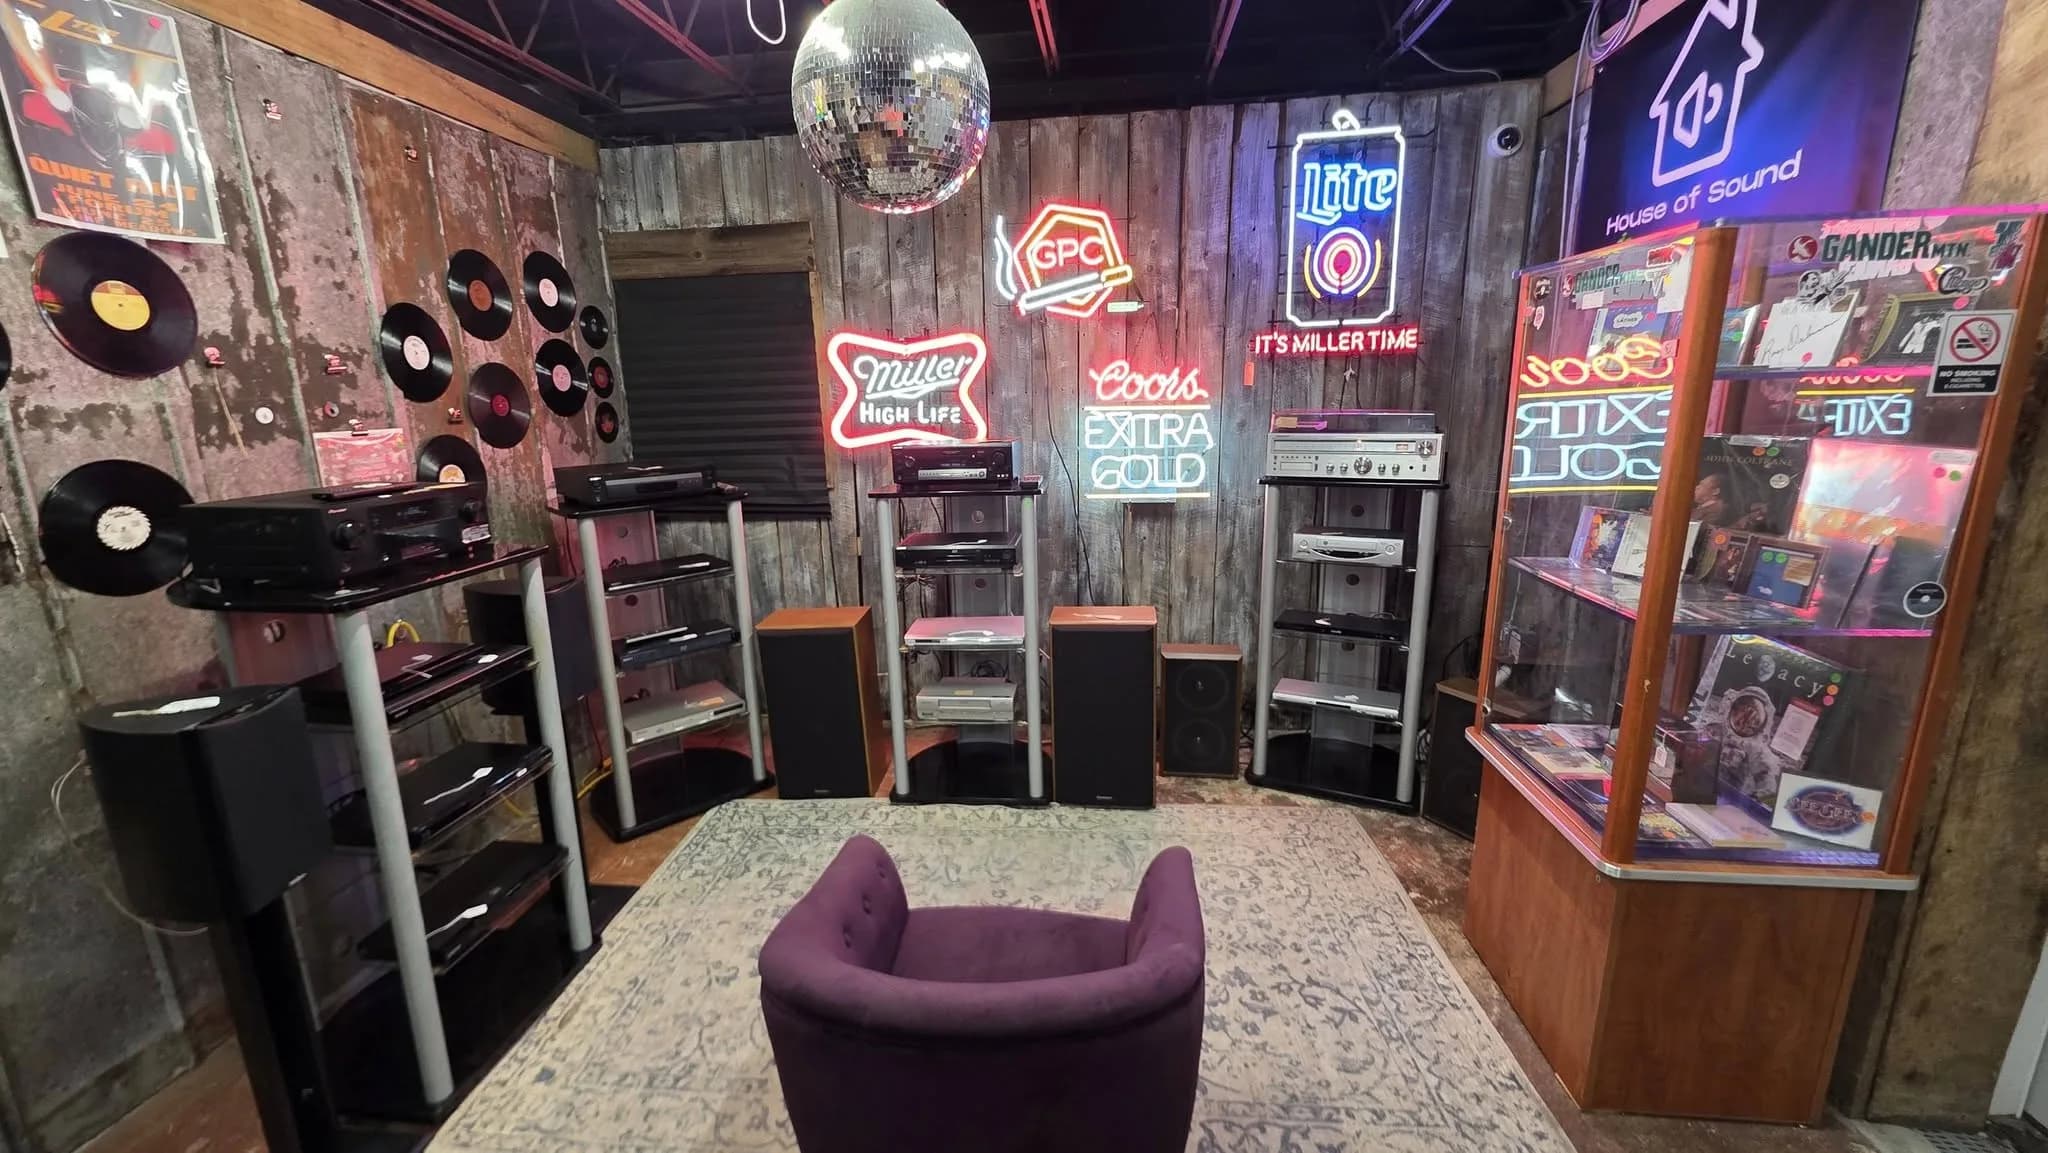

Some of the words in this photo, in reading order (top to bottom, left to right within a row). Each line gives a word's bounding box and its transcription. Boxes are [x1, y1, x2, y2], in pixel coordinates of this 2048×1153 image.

[28, 154, 115, 188] QUIET
[1296, 162, 1397, 225] Lite
[1606, 202, 1668, 236] House
[1673, 184, 1702, 214] of
[1707, 149, 1803, 204] Sound
[1031, 236, 1104, 269] GPC
[1823, 231, 1932, 262] GANDER
[1255, 332, 1289, 354] IT'S
[1292, 330, 1364, 353] MILLER
[1367, 328, 1418, 351] TIME
[853, 355, 974, 399] Miller
[1088, 359, 1209, 401] Coors
[859, 401, 910, 425] HIGH
[917, 400, 961, 424] LIFE
[1084, 410, 1214, 450] EXTRA
[1091, 453, 1206, 490] GOLD
